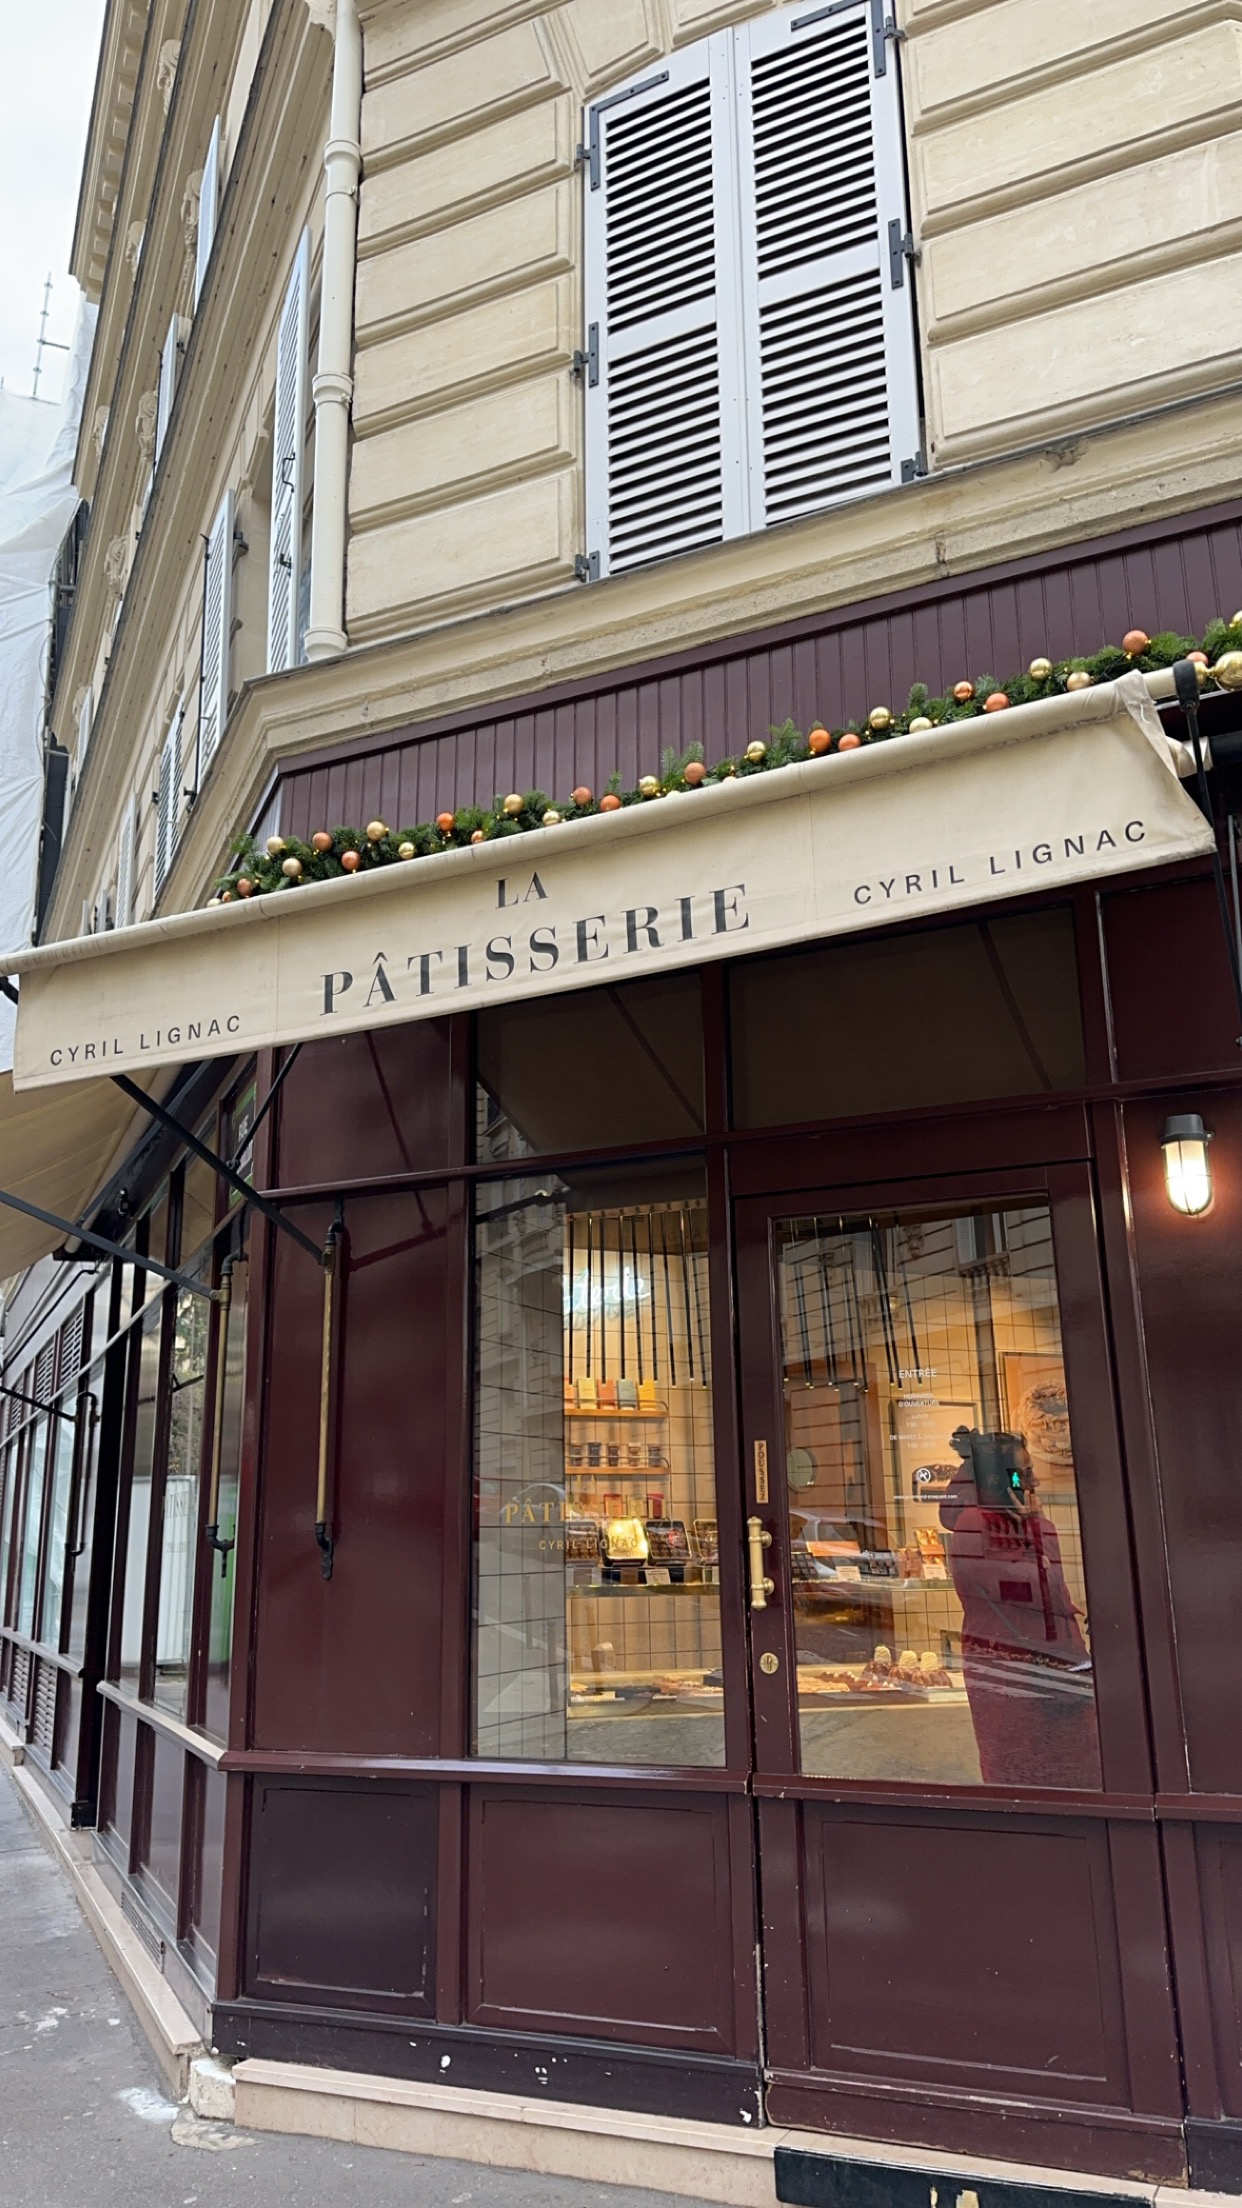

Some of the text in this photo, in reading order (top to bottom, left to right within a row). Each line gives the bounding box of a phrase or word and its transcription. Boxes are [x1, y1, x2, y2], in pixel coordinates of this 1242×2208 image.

[854, 820, 1147, 906] CYRIL LIGNAC
[494, 870, 549, 910] LA
[319, 883, 750, 1017] PÂTISSERIE
[50, 1015, 241, 1067] CYRIL LIGNAC
[898, 1367, 938, 1378] ENTRÉE
[757, 1443, 766, 1501] POUSSEZ
[538, 1537, 639, 1551] CYRIL LIGNAC
